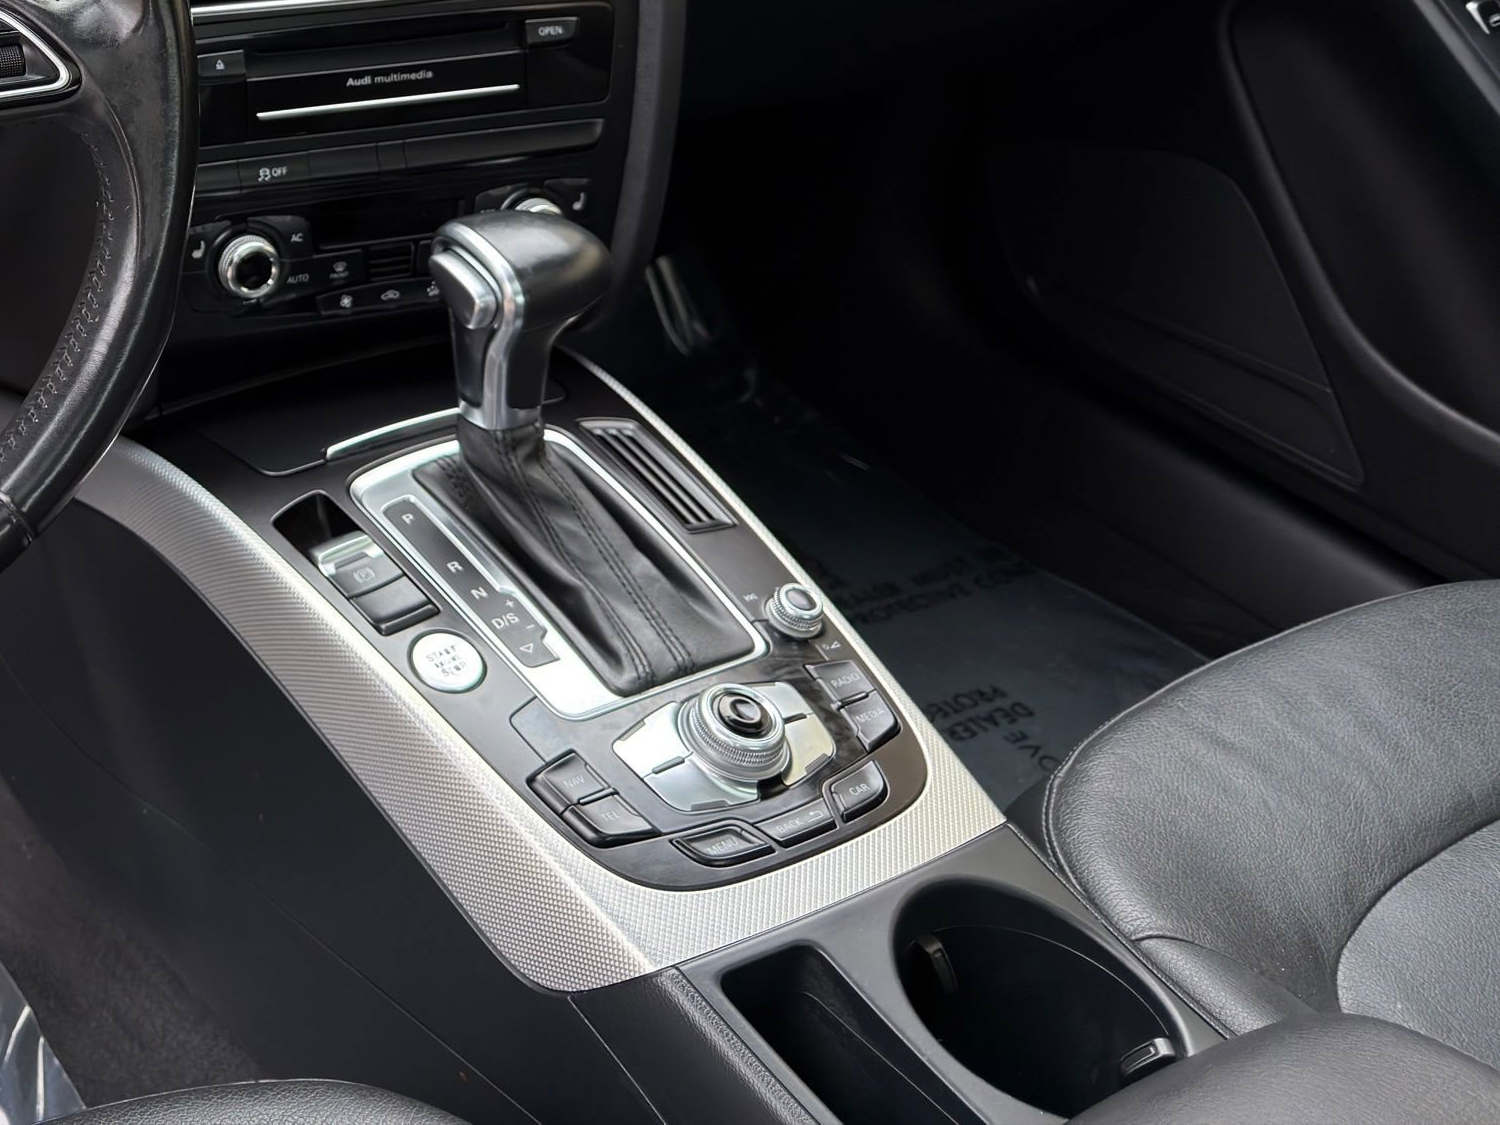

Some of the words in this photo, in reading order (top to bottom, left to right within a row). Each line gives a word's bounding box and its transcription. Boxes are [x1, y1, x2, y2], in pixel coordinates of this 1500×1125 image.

[538, 25, 564, 37] OPEN
[346, 75, 372, 87] Audi
[374, 69, 434, 84] multimedia
[271, 165, 288, 178] OFF
[401, 513, 415, 526] P
[446, 560, 464, 574] R
[470, 586, 489, 601] N
[491, 612, 520, 629] D/S
[830, 673, 861, 689] RADIO
[856, 707, 884, 724] MEDIA
[564, 775, 586, 789] NAV
[849, 782, 871, 797] CAR
[601, 811, 619, 822] TEL
[777, 819, 803, 835] BACK
[706, 836, 739, 856] MENU
